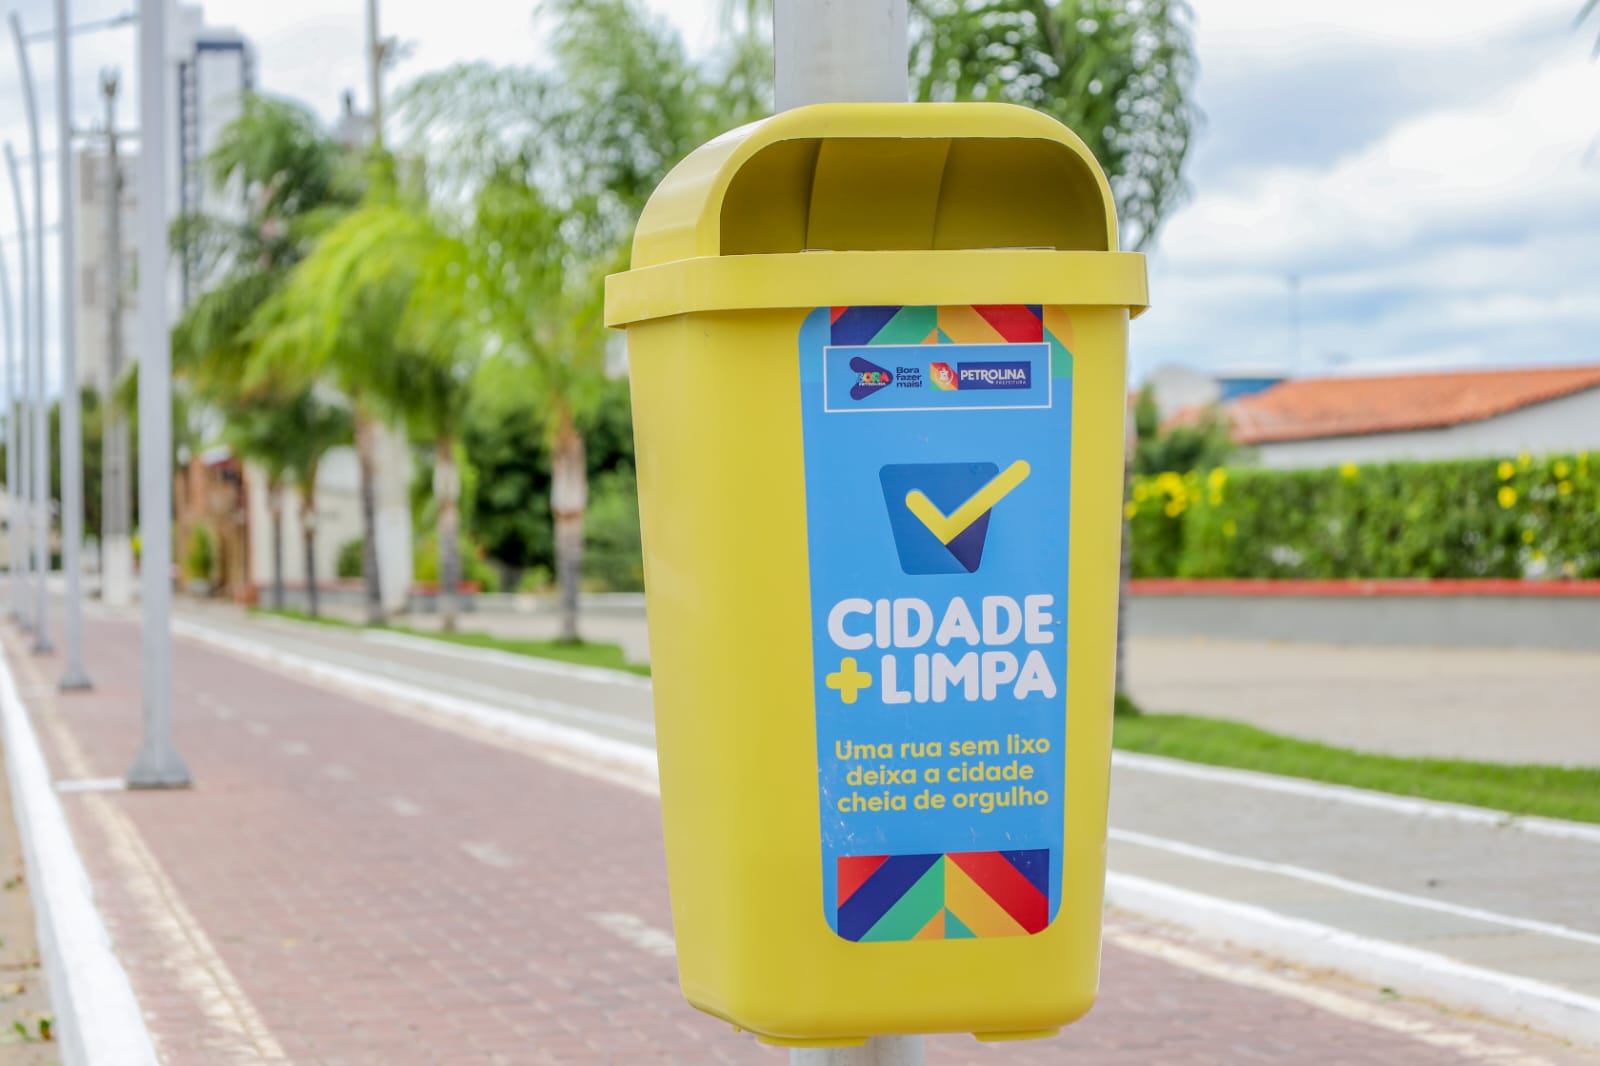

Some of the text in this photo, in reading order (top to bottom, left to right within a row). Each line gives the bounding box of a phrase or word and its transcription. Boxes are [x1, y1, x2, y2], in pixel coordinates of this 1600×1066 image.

[896, 366, 920, 374] Bora
[960, 369, 1026, 384] PETROLINA
[896, 381, 923, 389] mais!
[827, 594, 1054, 650] CIDADE
[881, 650, 1057, 704] LIMPA
[835, 734, 1050, 760] Uma rua sem lixo
[846, 760, 1034, 786] deixa a cidade
[837, 786, 1049, 813] cheia de orgulho
